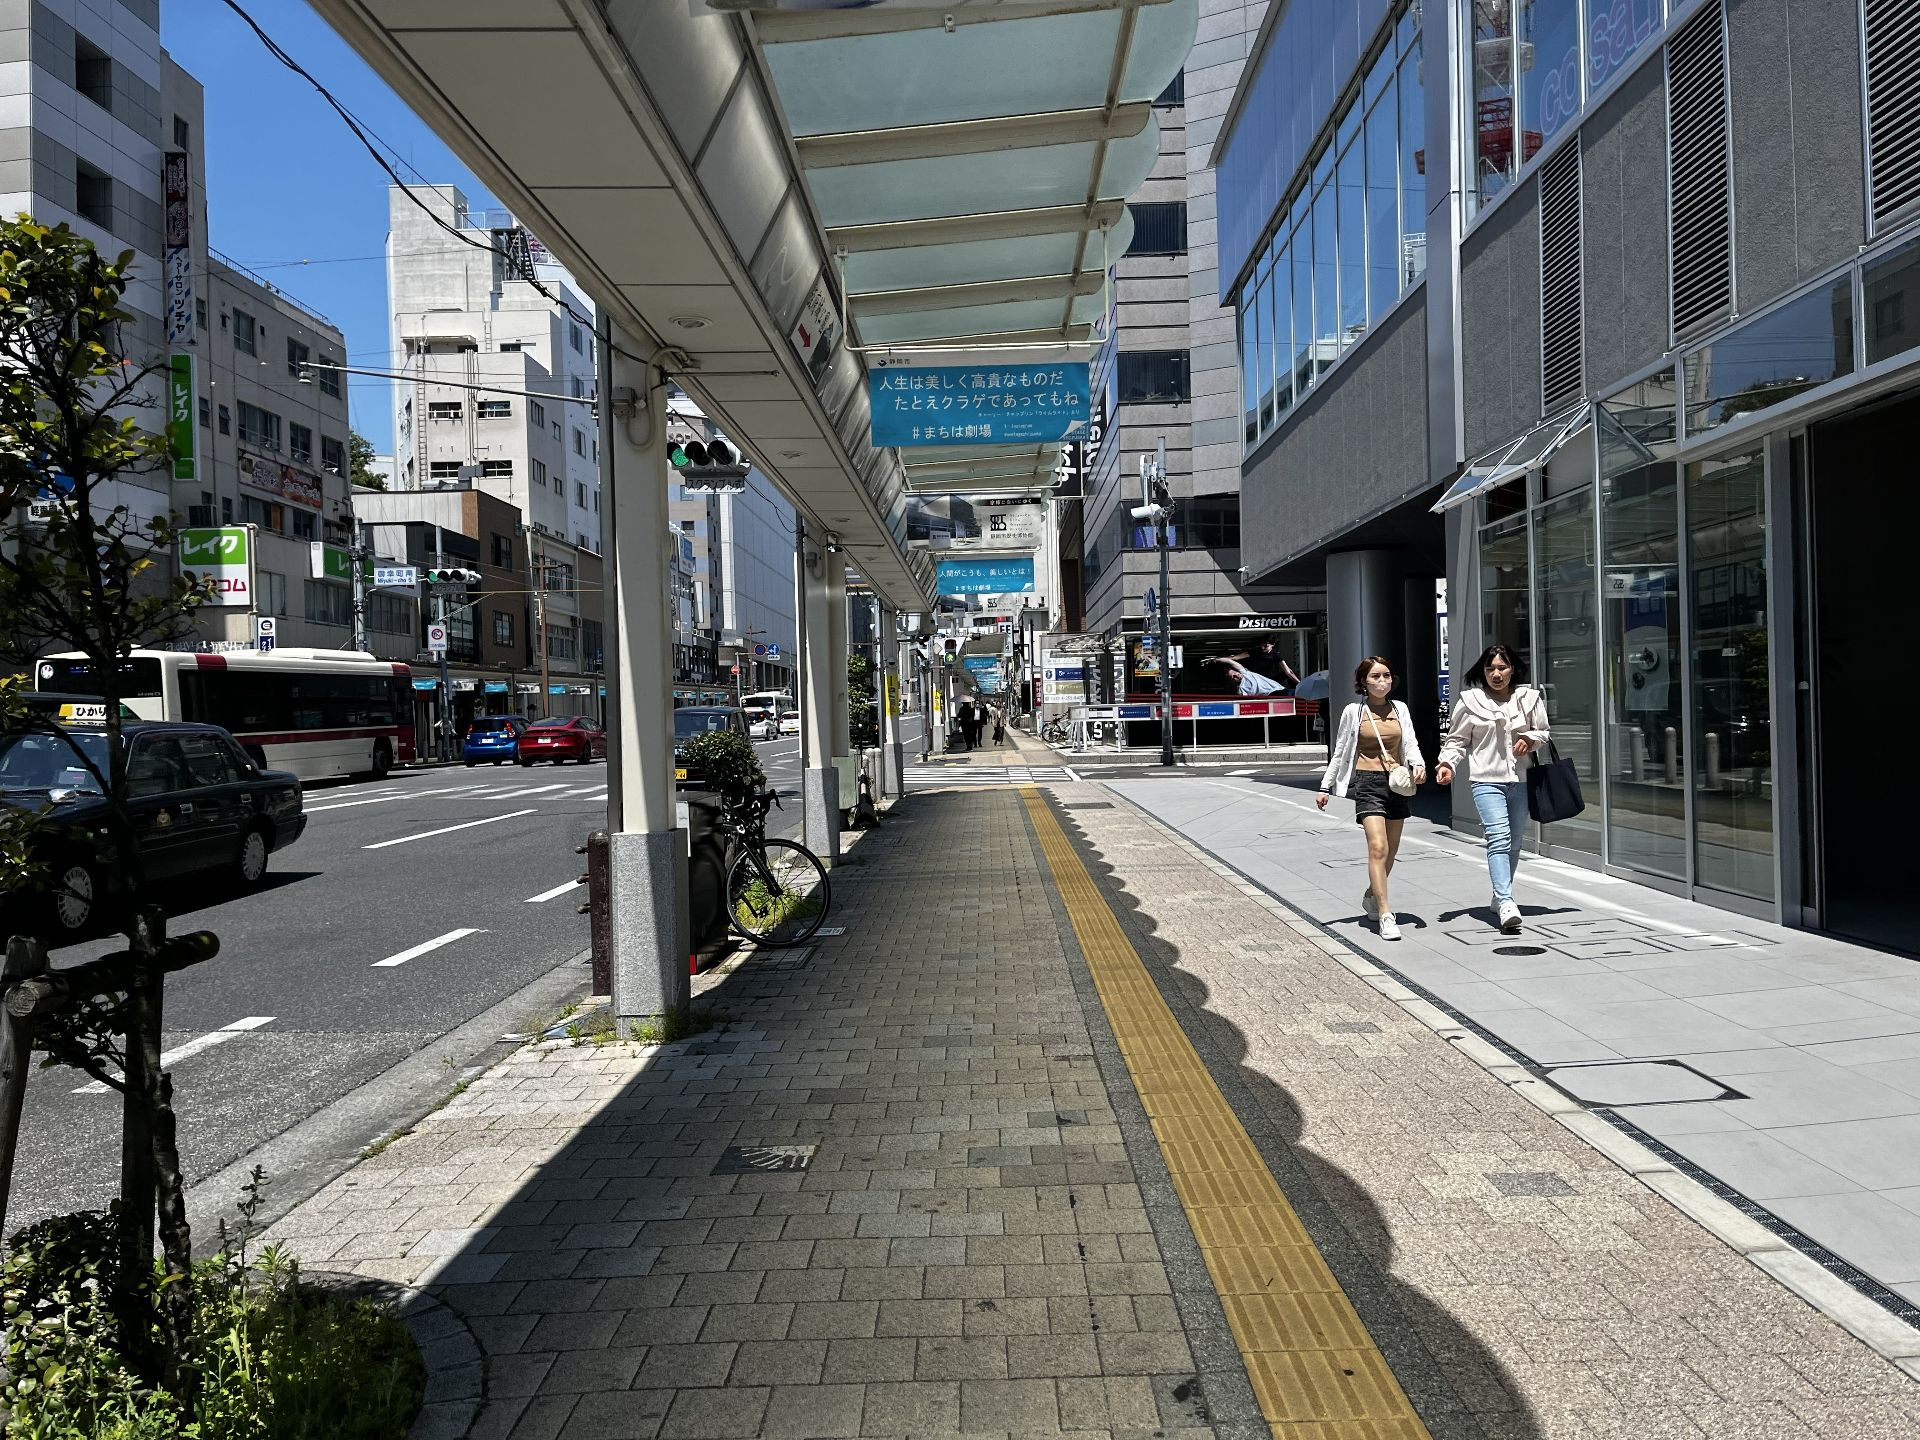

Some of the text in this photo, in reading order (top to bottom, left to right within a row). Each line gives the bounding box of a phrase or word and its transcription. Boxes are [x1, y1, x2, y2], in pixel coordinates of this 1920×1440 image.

[175, 299, 186, 334] ツチヤ
[879, 370, 1064, 391] 人生は美しく高貴なものだ
[175, 383, 189, 422] レイク
[894, 391, 1079, 411] たとえクラゲであってもね
[183, 535, 238, 555] レイク
[1239, 614, 1297, 628] Dr.stretch
